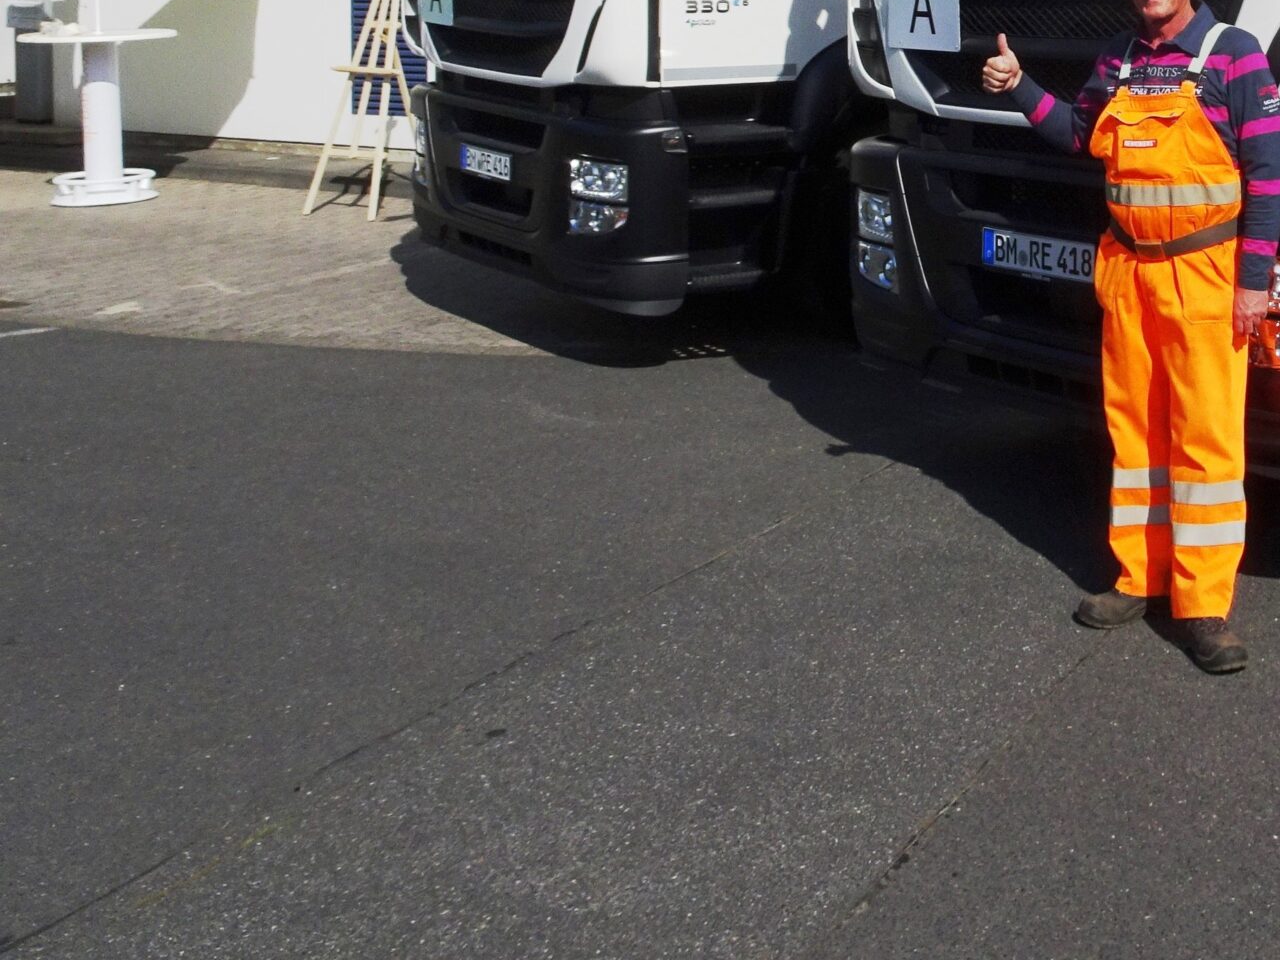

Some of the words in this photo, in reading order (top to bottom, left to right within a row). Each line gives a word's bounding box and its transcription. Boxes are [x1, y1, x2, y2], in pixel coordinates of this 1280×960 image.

[685, 0, 730, 14] 330
[995, 234, 1017, 265] BM
[1029, 240, 1053, 271] RE
[1057, 245, 1092, 277] 418
